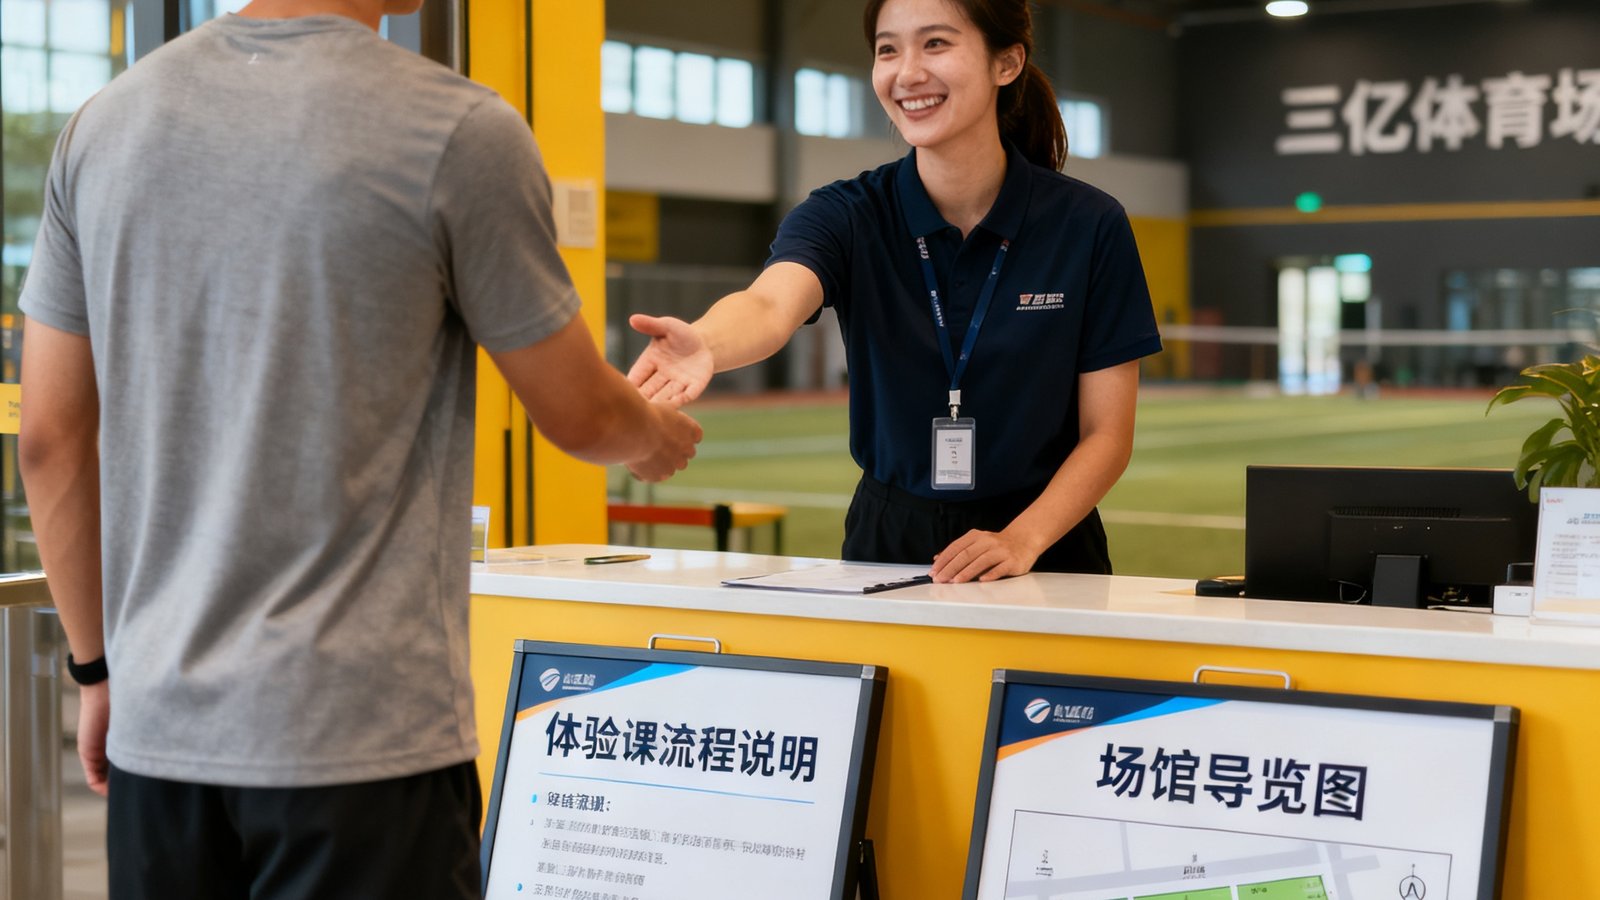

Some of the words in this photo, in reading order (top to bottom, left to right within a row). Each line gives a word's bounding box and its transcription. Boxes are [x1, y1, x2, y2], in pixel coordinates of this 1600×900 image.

[1276, 68, 1600, 156] 三亿体育场
[545, 711, 819, 783] 体验课流程说明
[1096, 743, 1368, 821] 场馆导览图
